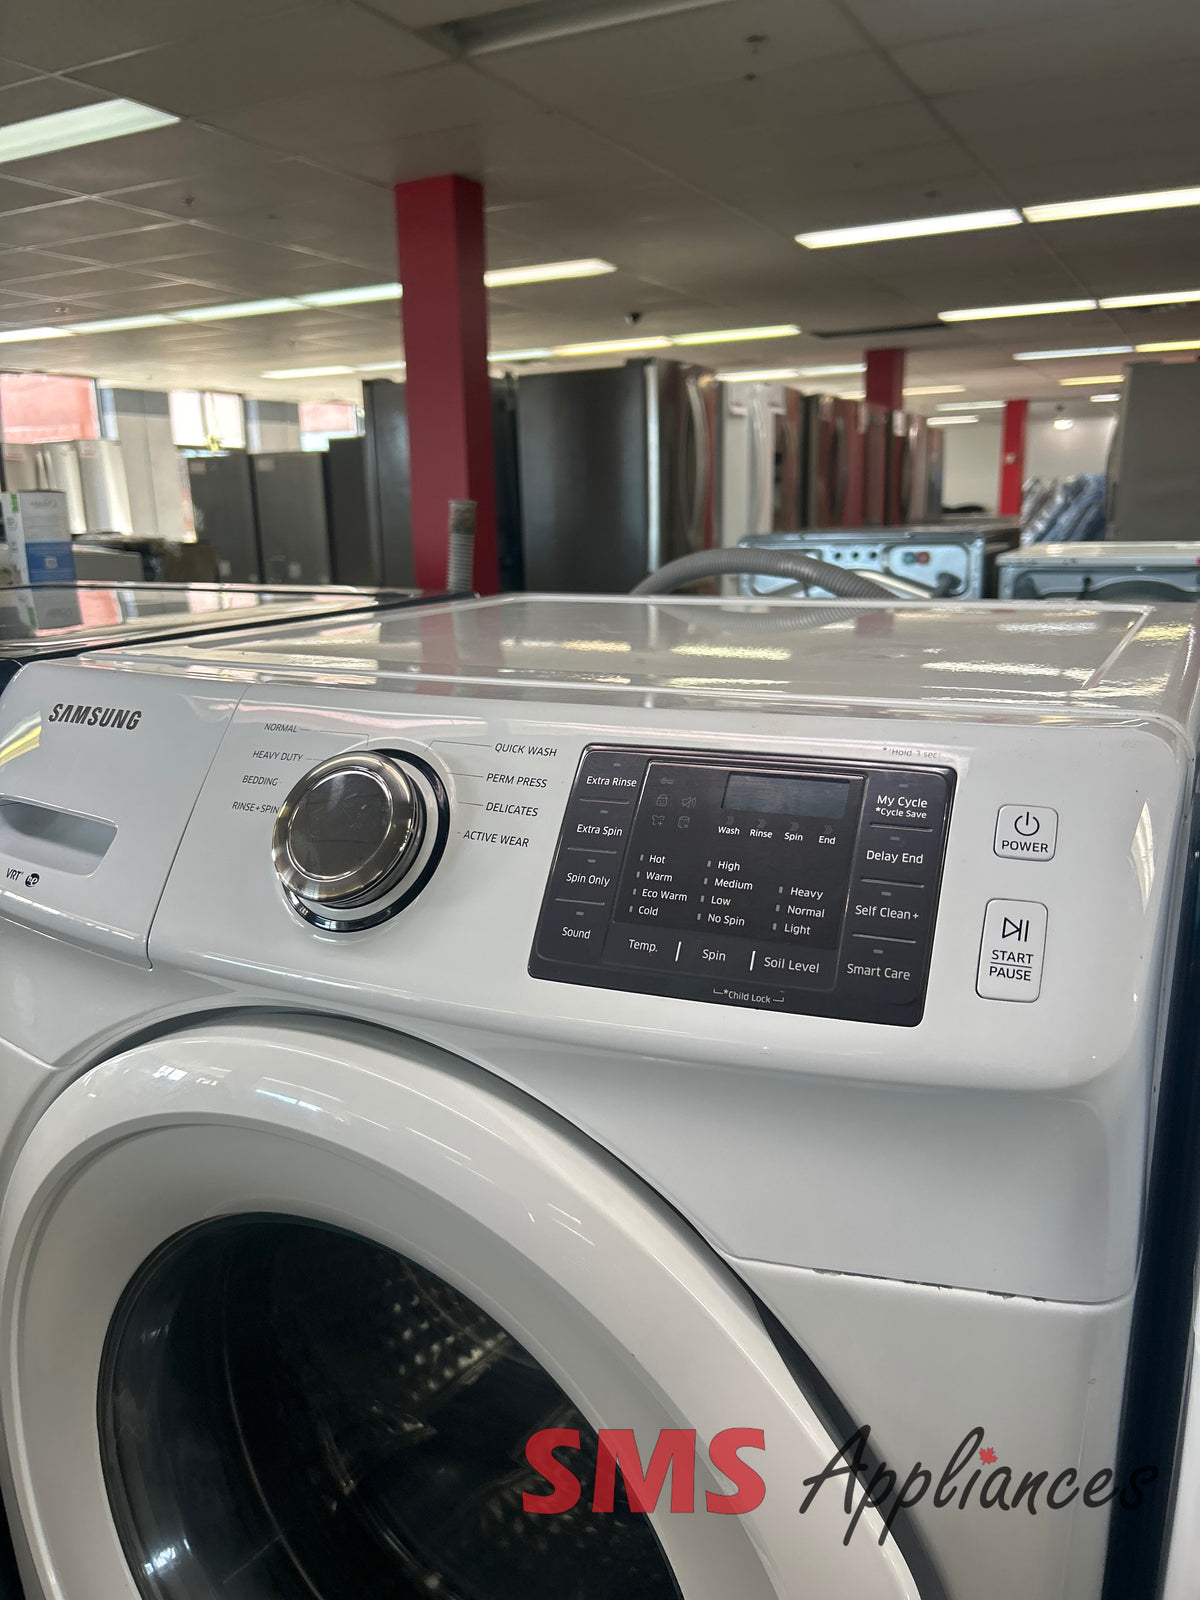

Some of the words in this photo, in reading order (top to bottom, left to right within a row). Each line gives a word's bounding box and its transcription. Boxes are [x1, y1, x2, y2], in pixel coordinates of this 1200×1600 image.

[48, 703, 142, 731] SAMSUNG
[263, 722, 298, 734] NORMAL
[252, 750, 280, 761] HEAVY
[281, 751, 304, 763] DUTY
[495, 742, 525, 755] QUICK
[527, 744, 558, 758] WASH
[242, 775, 278, 787] BEDDING
[486, 772, 514, 785] PERM
[517, 775, 548, 788] PRESS
[586, 775, 609, 787] Extra
[612, 776, 637, 788] Rinse
[231, 801, 280, 814] RINSE+SPIN
[877, 794, 895, 808] My
[897, 796, 928, 809] Cycle
[485, 801, 539, 817] DELICATES
[905, 809, 927, 819] Save
[576, 823, 600, 834] Extra
[602, 825, 623, 838] Spin
[717, 825, 740, 836] Wash
[749, 827, 773, 839] Rinse
[783, 831, 803, 843] Spin
[463, 829, 497, 844] ACTIVE
[499, 834, 530, 847] WEAR
[817, 835, 836, 845] End
[1001, 839, 1049, 853] POWER
[649, 853, 665, 864] Hot
[866, 850, 898, 864] Delay
[901, 852, 923, 864] End
[717, 860, 740, 872] High
[566, 873, 586, 884] Spin
[587, 874, 610, 887] Only
[645, 871, 673, 882] Warm
[714, 878, 754, 890] Medium
[641, 889, 658, 899] Eco
[661, 891, 688, 902] Warm
[790, 886, 824, 900] Heavy
[710, 895, 731, 906] Low
[637, 905, 659, 917] Cold
[787, 905, 825, 918] Normal
[854, 904, 877, 918] Self
[707, 913, 722, 924] No
[723, 914, 745, 927] Spin
[561, 927, 591, 939] Sound
[784, 923, 811, 937] Light
[628, 938, 658, 954] Temp.
[702, 948, 726, 963] Spin
[991, 949, 1034, 964] START
[763, 955, 784, 969] Soil
[786, 958, 820, 974] Level
[846, 963, 880, 977] Smart
[883, 967, 911, 981] Care
[989, 966, 1032, 981] PAUSE
[751, 991, 771, 1004] Lock
